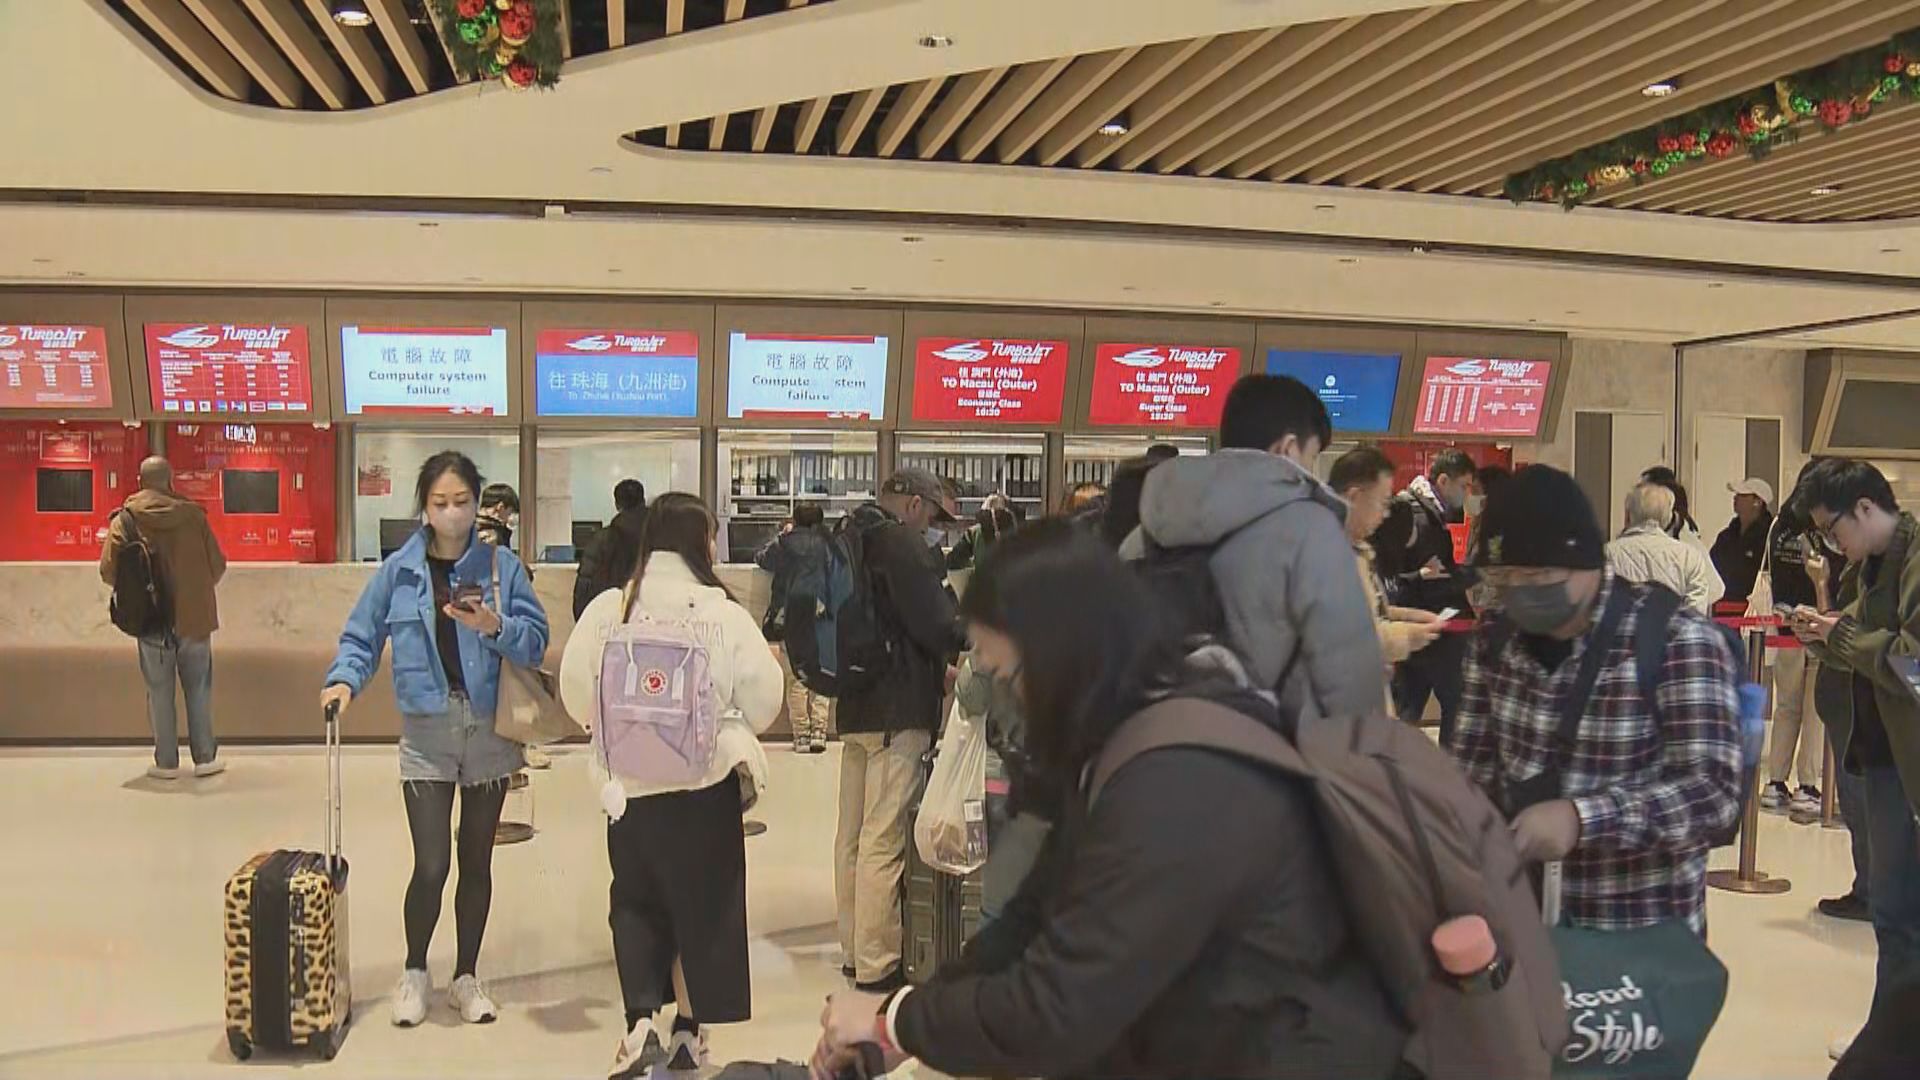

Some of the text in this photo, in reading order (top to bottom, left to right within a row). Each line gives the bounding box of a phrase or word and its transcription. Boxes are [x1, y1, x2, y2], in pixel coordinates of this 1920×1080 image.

[368, 370, 487, 383] Computer system
[406, 384, 451, 395] failure
[960, 379, 995, 389] Macau
[1136, 383, 1170, 394] Macau
[1563, 1009, 1664, 1064] Style
